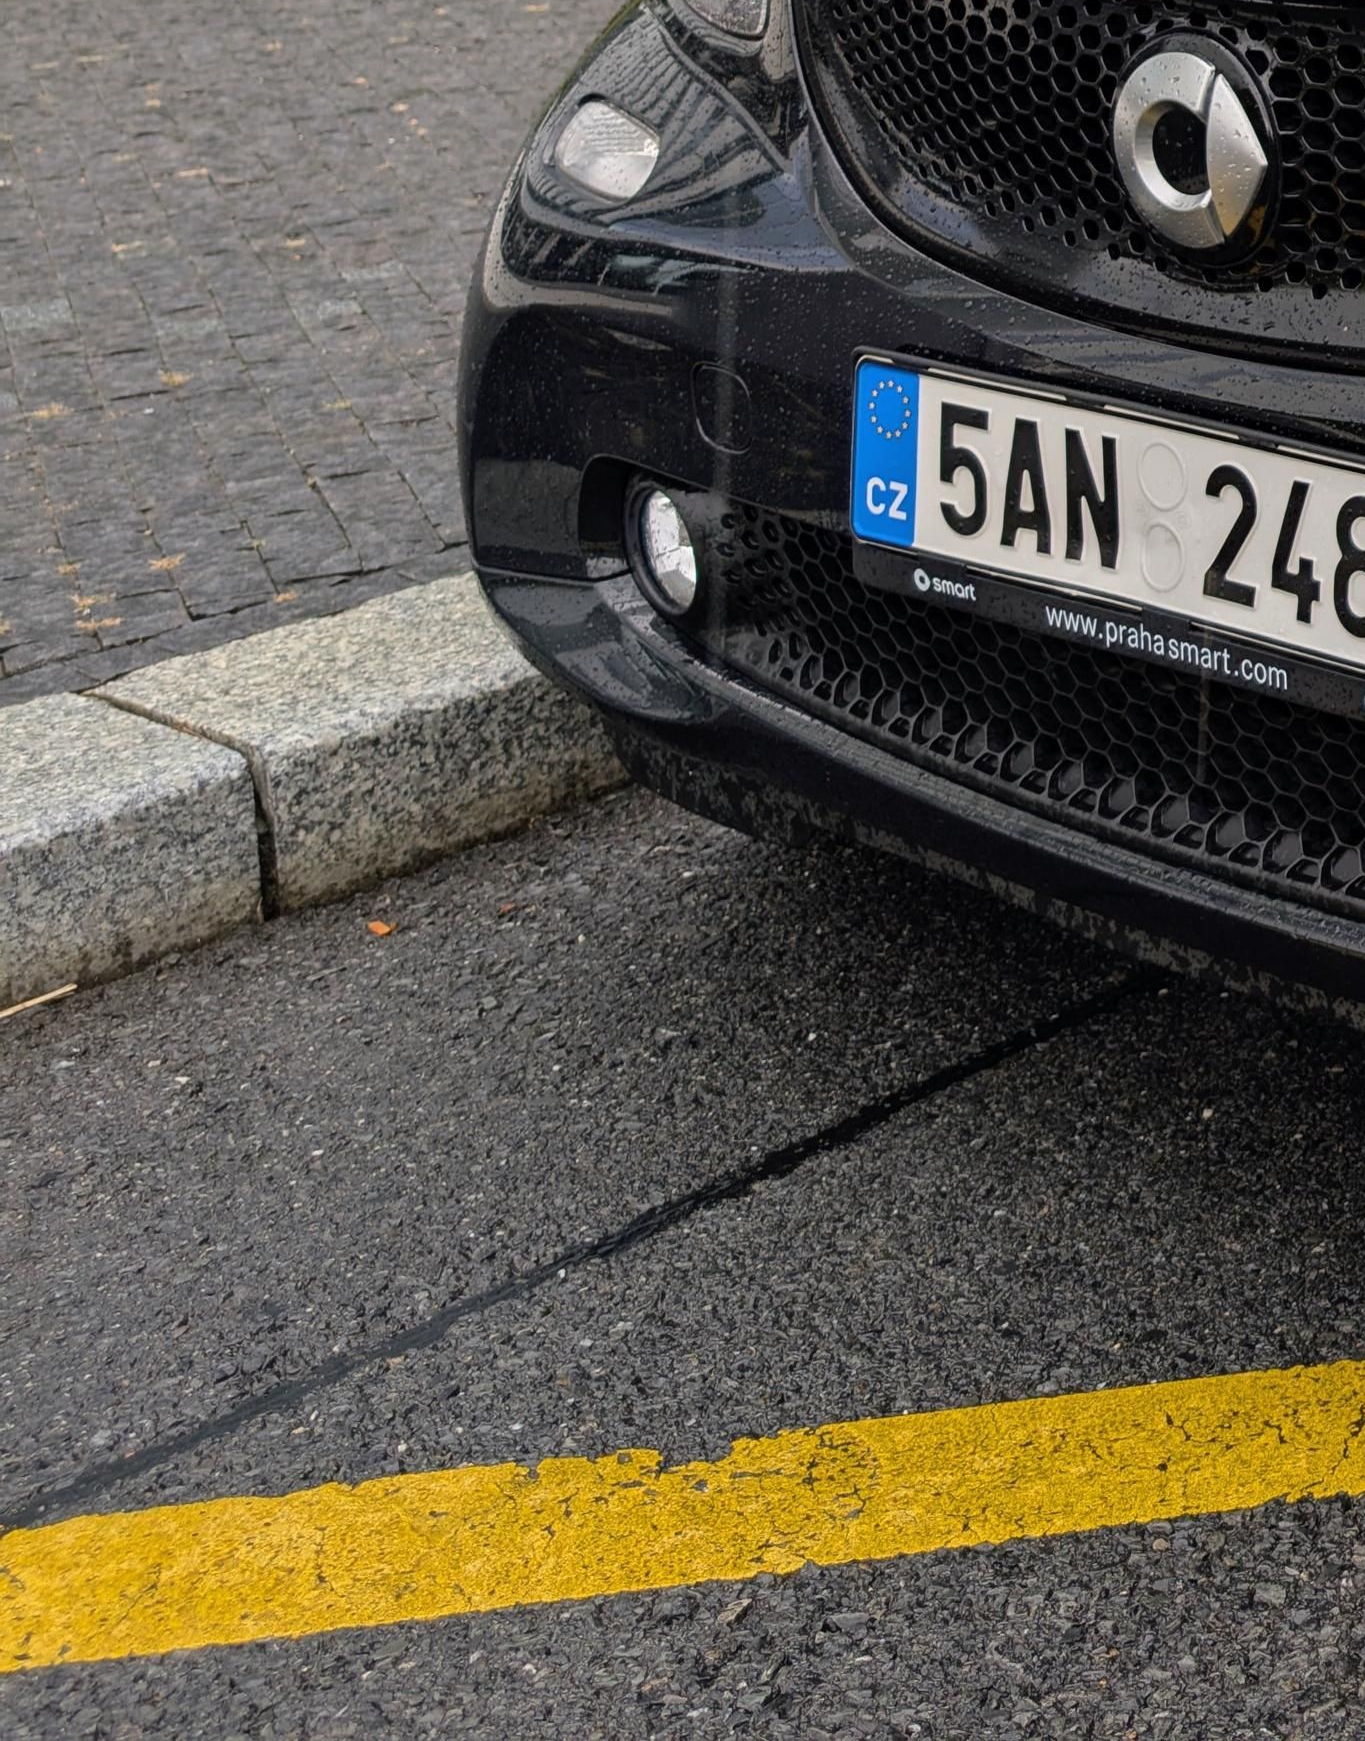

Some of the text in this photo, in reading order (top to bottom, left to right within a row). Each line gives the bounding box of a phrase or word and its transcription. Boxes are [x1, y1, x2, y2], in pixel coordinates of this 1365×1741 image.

[866, 476, 909, 521] CZ
[940, 401, 1119, 569] 5AN
[932, 576, 976, 601] smart
